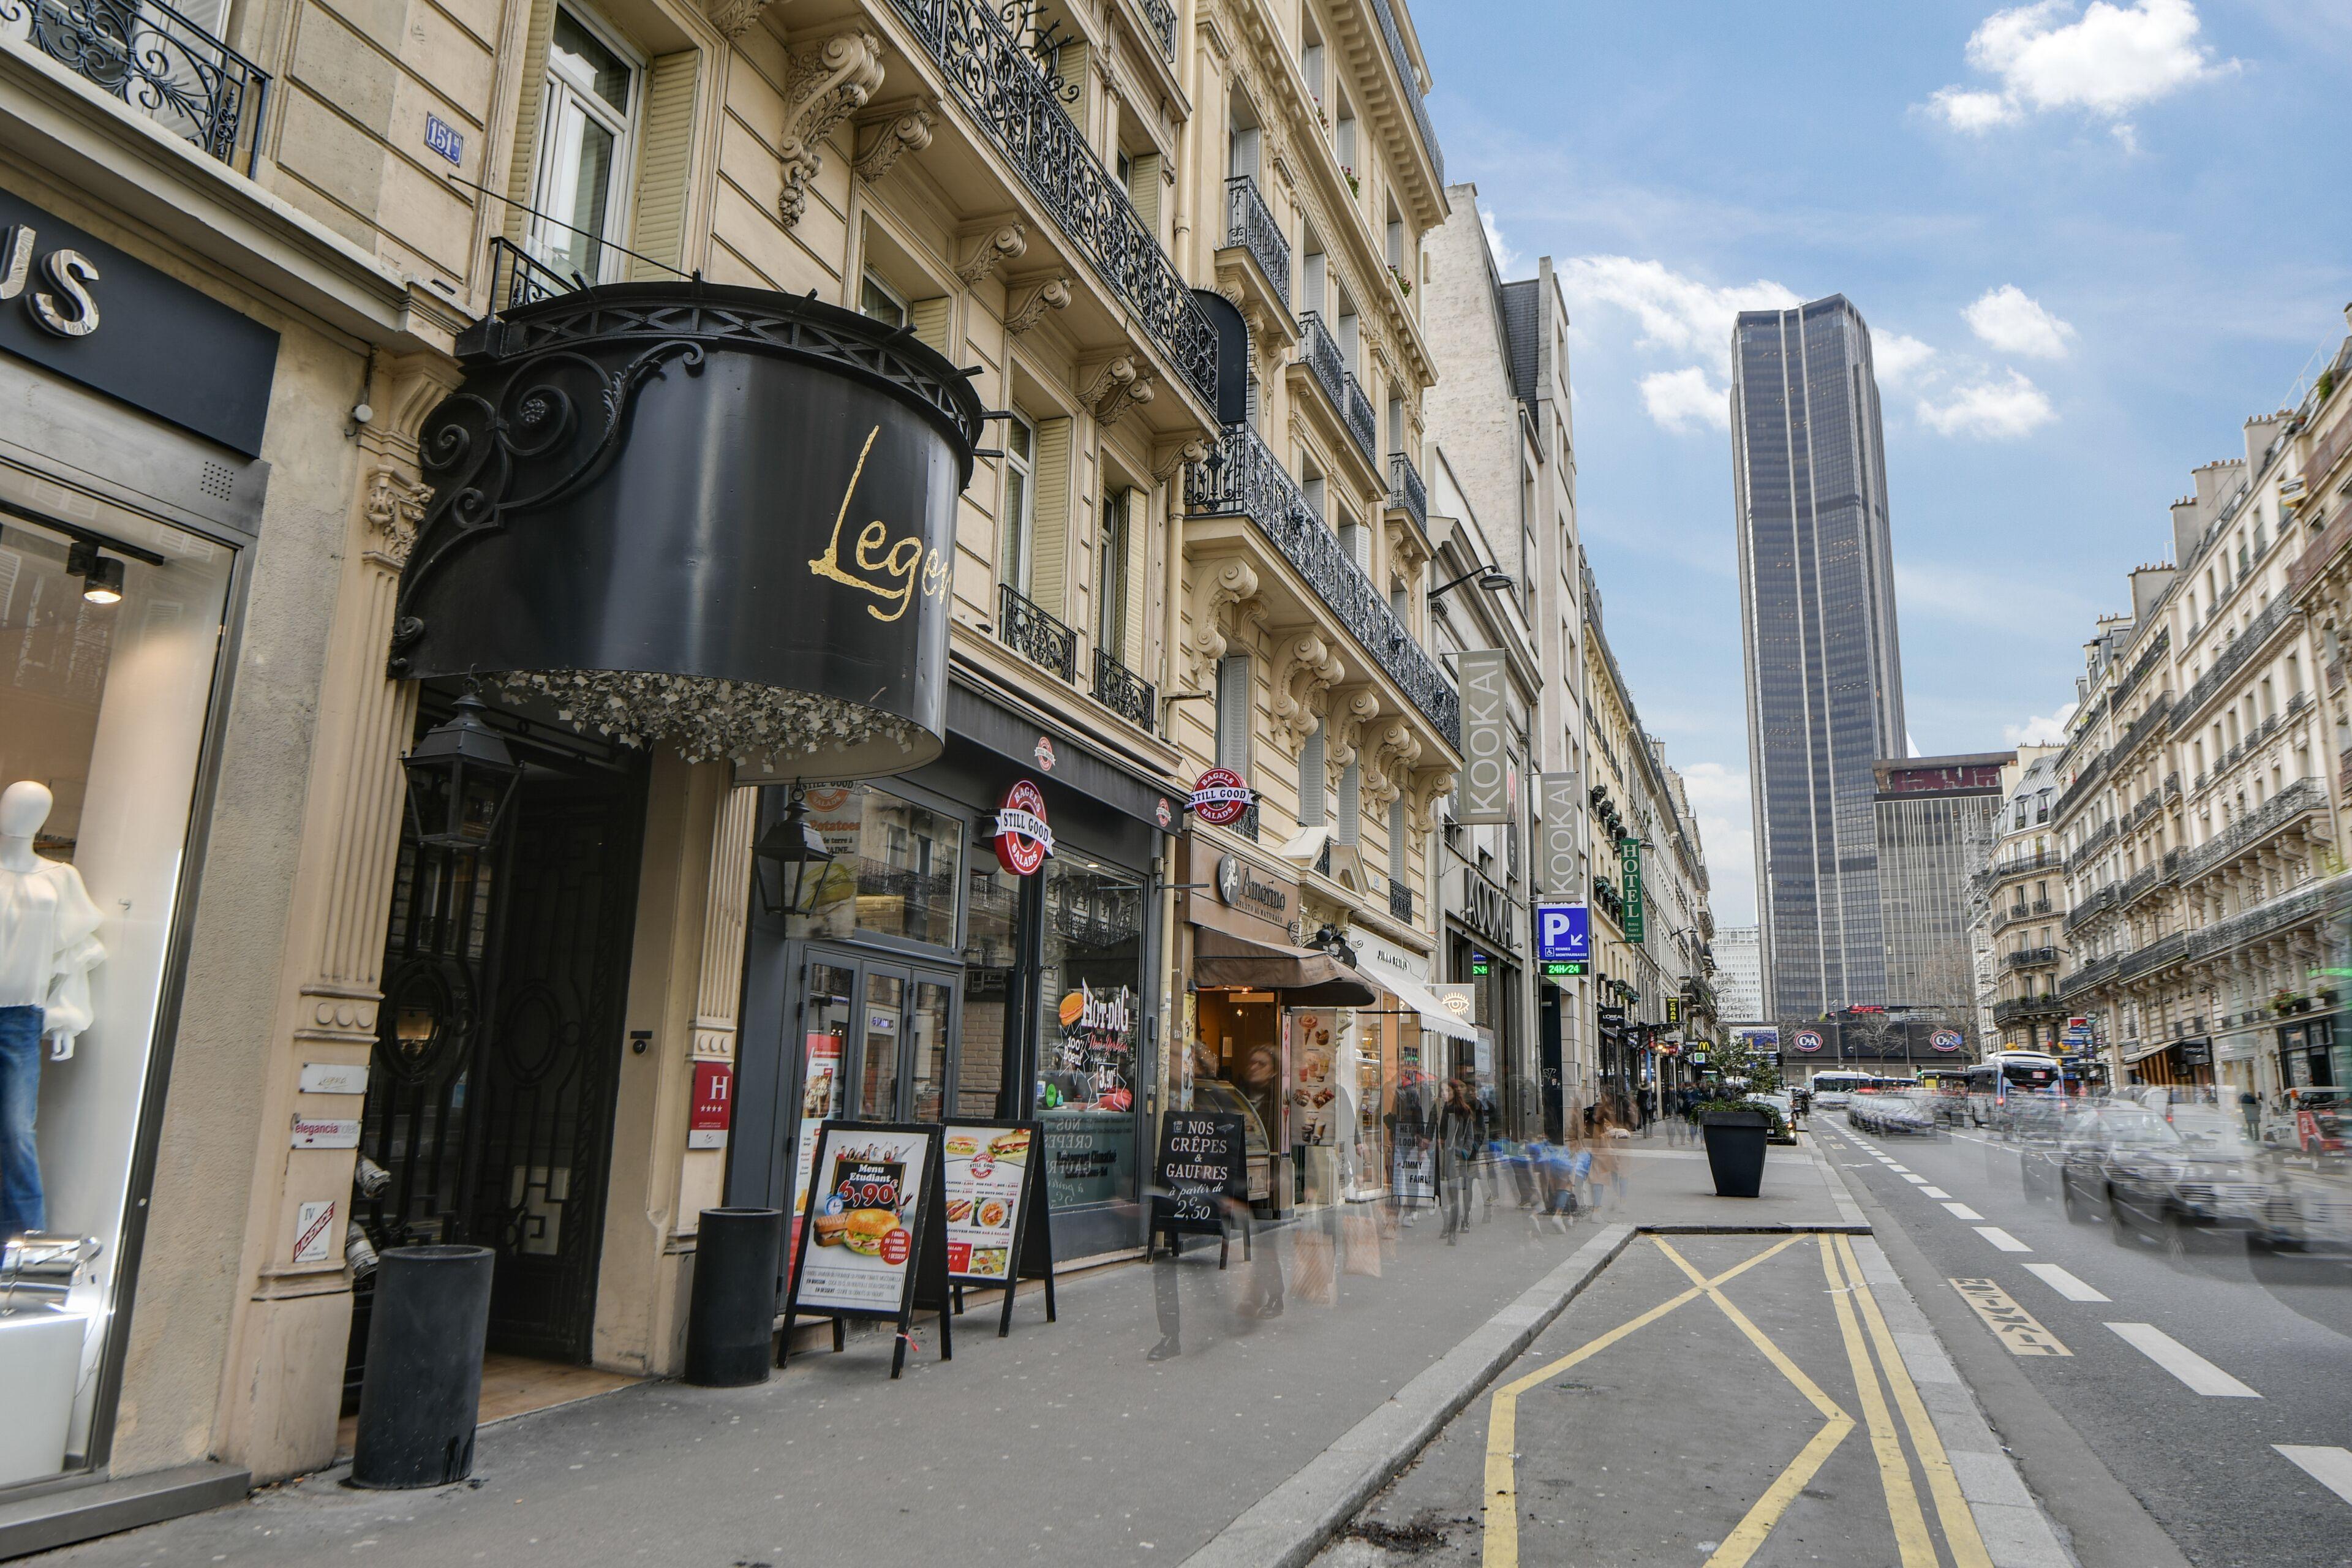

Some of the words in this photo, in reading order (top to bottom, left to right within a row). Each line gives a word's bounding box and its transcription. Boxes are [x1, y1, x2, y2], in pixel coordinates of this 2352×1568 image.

[429, 121, 452, 155] 151
[1201, 772, 1234, 786] BAGELS
[1014, 786, 1041, 813] BAGELS
[1190, 790, 1216, 803] STILL
[1220, 790, 1246, 799] GOOD
[1201, 807, 1234, 820] SALADS
[810, 820, 861, 831] Potatoes
[1003, 813, 1025, 829] STILL
[1028, 818, 1049, 842] GOOD
[1011, 842, 1038, 867] SALADS
[1622, 845, 1640, 918] HOTEL
[1235, 900, 1254, 912] GELATO
[1261, 909, 1283, 923] NATURALE
[1544, 913, 1570, 946] P
[1548, 965, 1579, 974] 24H/24
[1068, 1036, 1085, 1054] 100%
[1799, 1036, 1818, 1046] C&A
[709, 1076, 729, 1100] H
[1188, 1121, 1215, 1135] NOS
[1400, 1125, 1412, 1133] HEY
[1170, 1136, 1227, 1153] CRÊPES
[1194, 1153, 1203, 1163] &
[1401, 1160, 1422, 1169] JIMMY
[858, 1164, 884, 1174] Menu
[1166, 1163, 1228, 1180] GAUFRES
[849, 1172, 892, 1182] Etudiant
[1168, 1186, 1176, 1196] à
[1177, 1183, 1210, 1201] partir
[1212, 1182, 1224, 1193] de
[305, 1207, 316, 1221] IV
[295, 1204, 334, 1256] LICENCE
